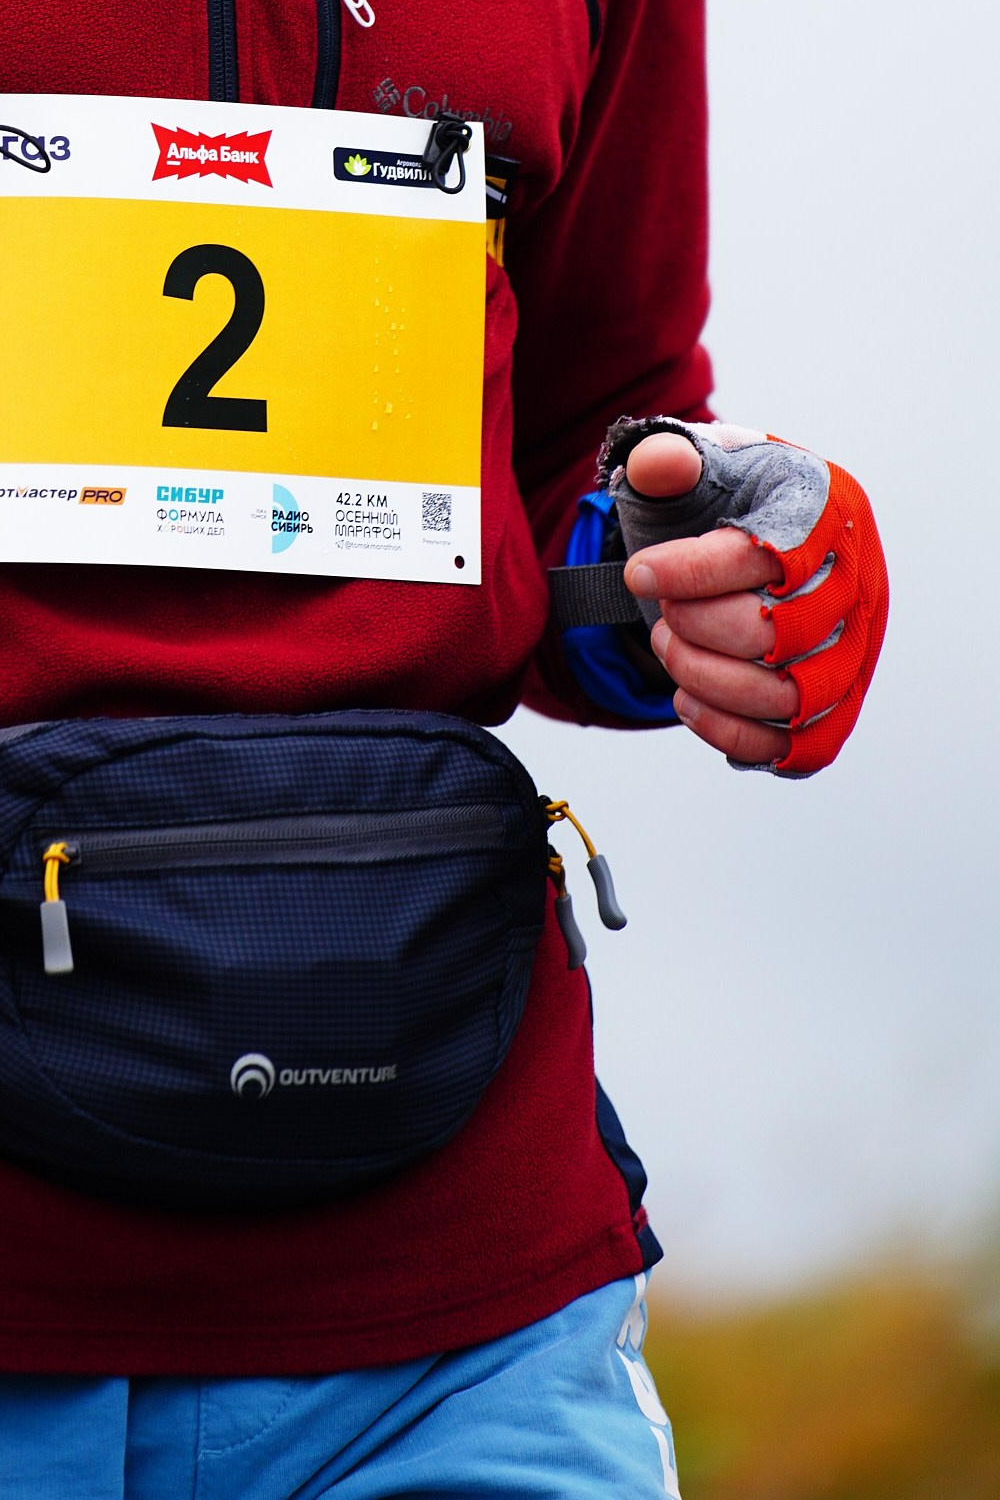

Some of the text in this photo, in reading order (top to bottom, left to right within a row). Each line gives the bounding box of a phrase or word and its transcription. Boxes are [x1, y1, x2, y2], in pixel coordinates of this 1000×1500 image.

[166, 142, 259, 165] Альфа Банк
[162, 243, 268, 433] 2
[81, 489, 123, 504] PRO
[156, 486, 224, 504] СИБУР
[336, 492, 388, 508] 42.2 КМ
[156, 507, 224, 523] ФОРМУЛА
[271, 509, 310, 522] РАДИО
[335, 509, 398, 526] ОСЕННИЙ
[207, 526, 225, 536] ДЕЛ
[271, 521, 314, 534] СИБИРЬ
[335, 524, 401, 540] МАРАФОН
[279, 1064, 397, 1086] OUTVENTURE
